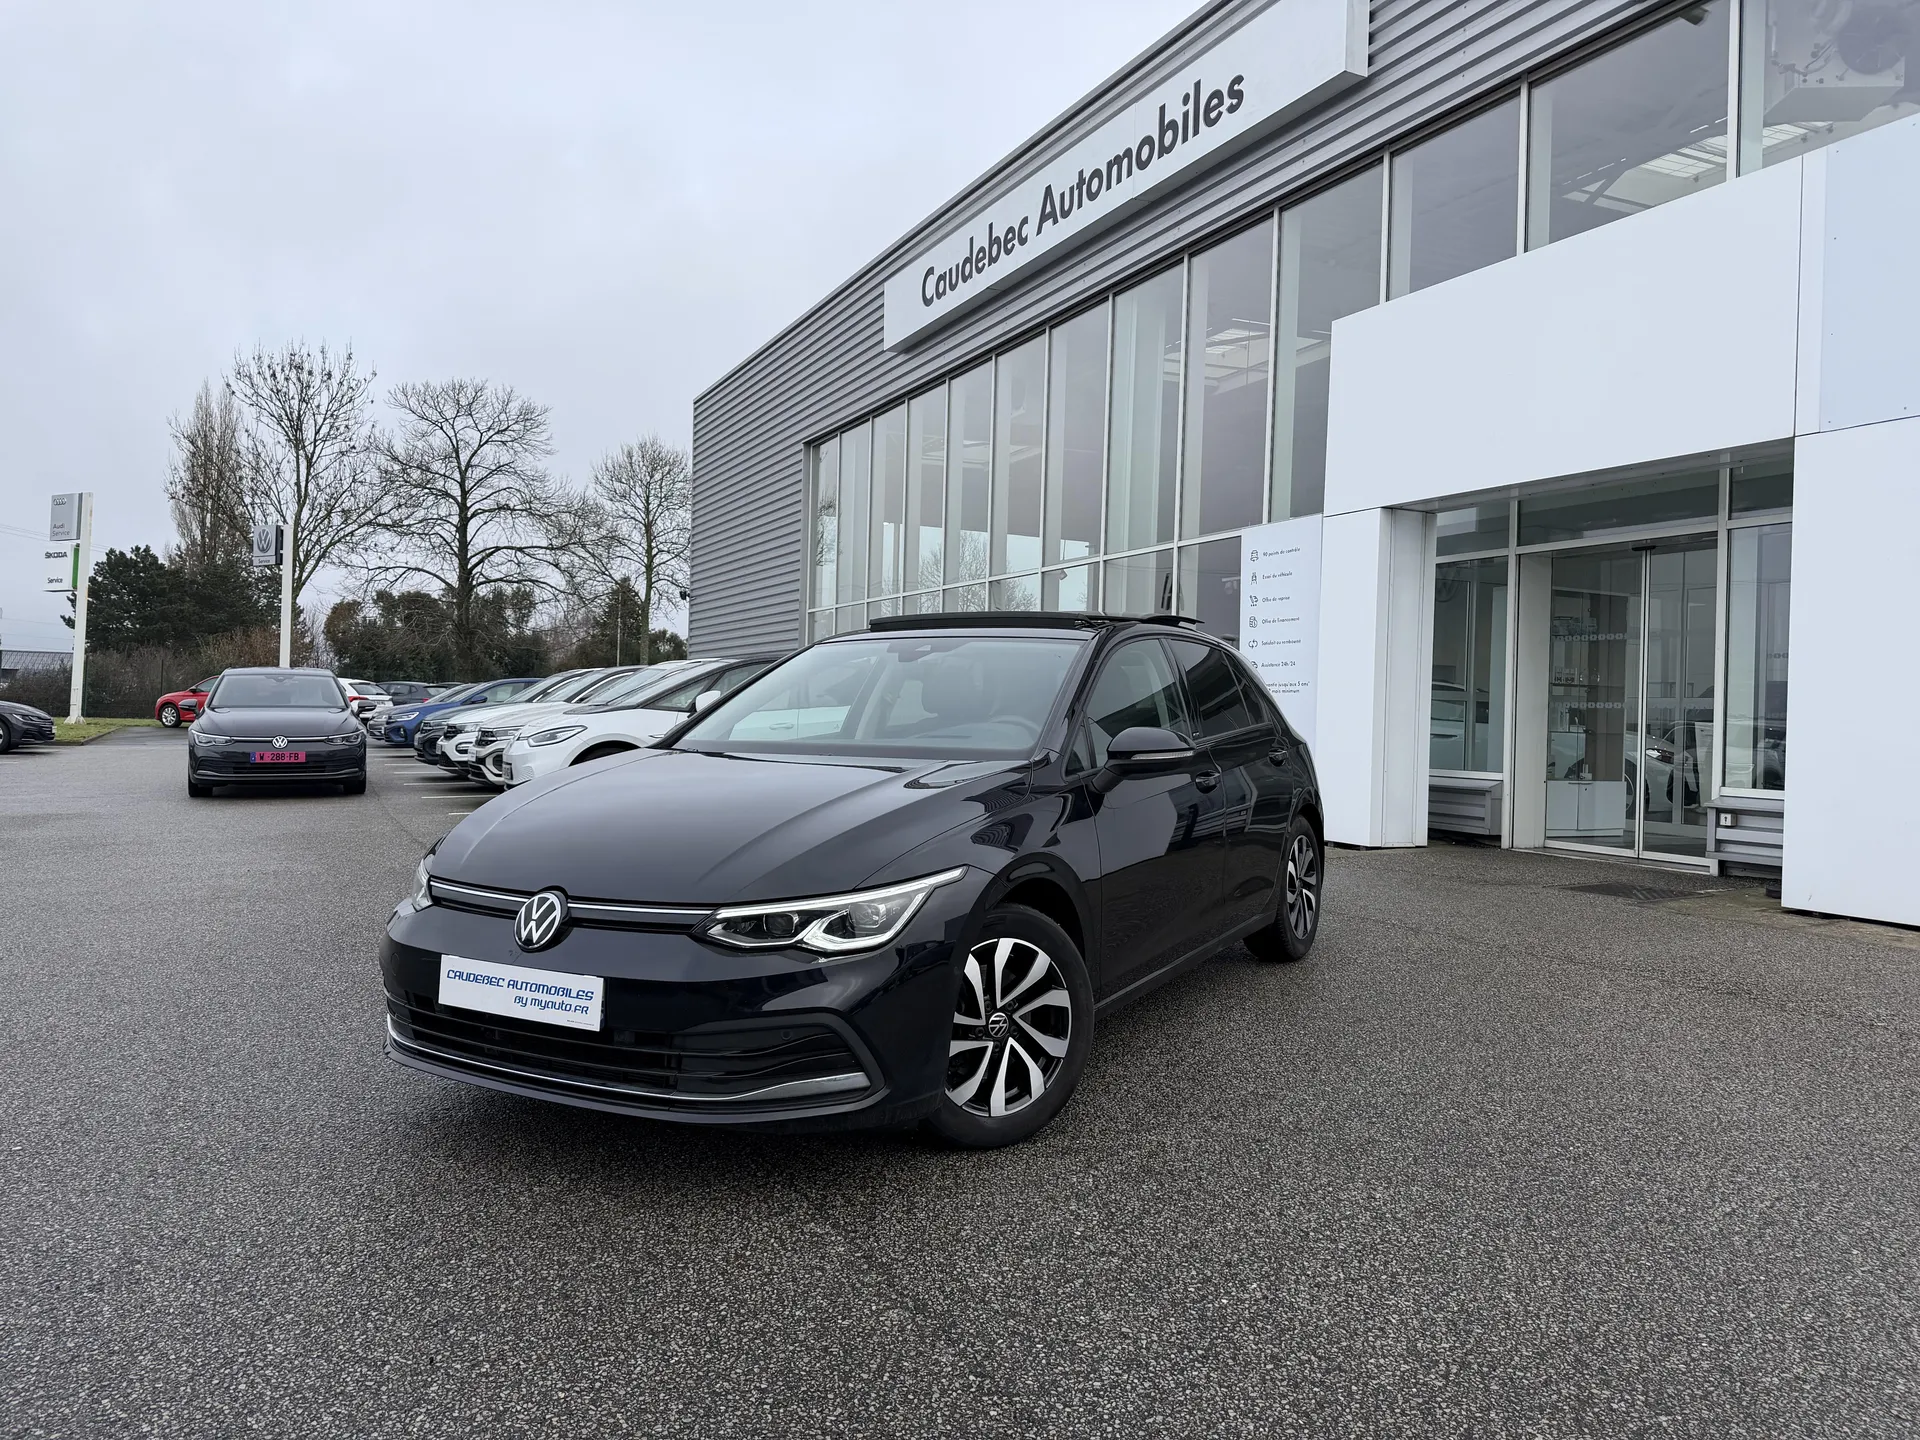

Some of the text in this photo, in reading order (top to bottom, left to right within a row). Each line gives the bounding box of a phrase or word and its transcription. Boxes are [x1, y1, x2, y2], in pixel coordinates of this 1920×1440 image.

[921, 73, 1245, 307] Caudebec Automobiles
[447, 969, 594, 1001] CAUDEBEC AUTOMOBILES
